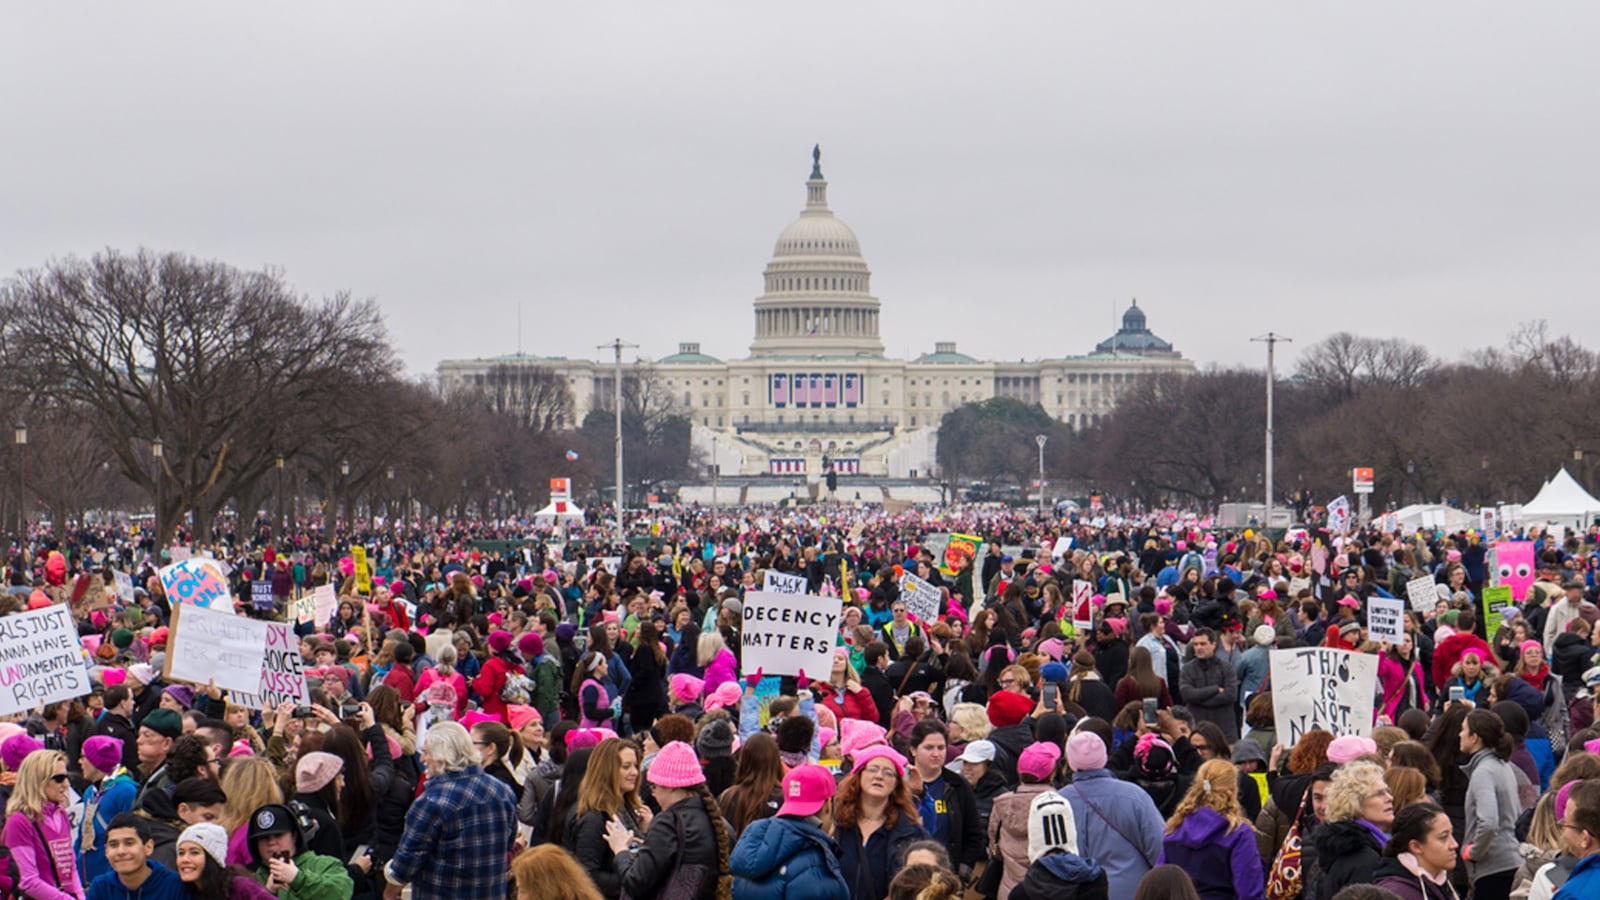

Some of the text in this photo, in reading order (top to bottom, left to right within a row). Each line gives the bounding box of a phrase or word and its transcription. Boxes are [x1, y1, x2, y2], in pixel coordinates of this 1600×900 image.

[162, 560, 189, 589] LET
[770, 575, 802, 592] BLACK
[27, 610, 64, 634] JUST
[188, 614, 260, 641] EQUALITY
[744, 606, 837, 627] DECENCY
[32, 635, 71, 655] HAVE
[742, 632, 829, 654] MATTERS
[183, 641, 248, 670] FOR ALL
[12, 670, 78, 705] RIGHTS
